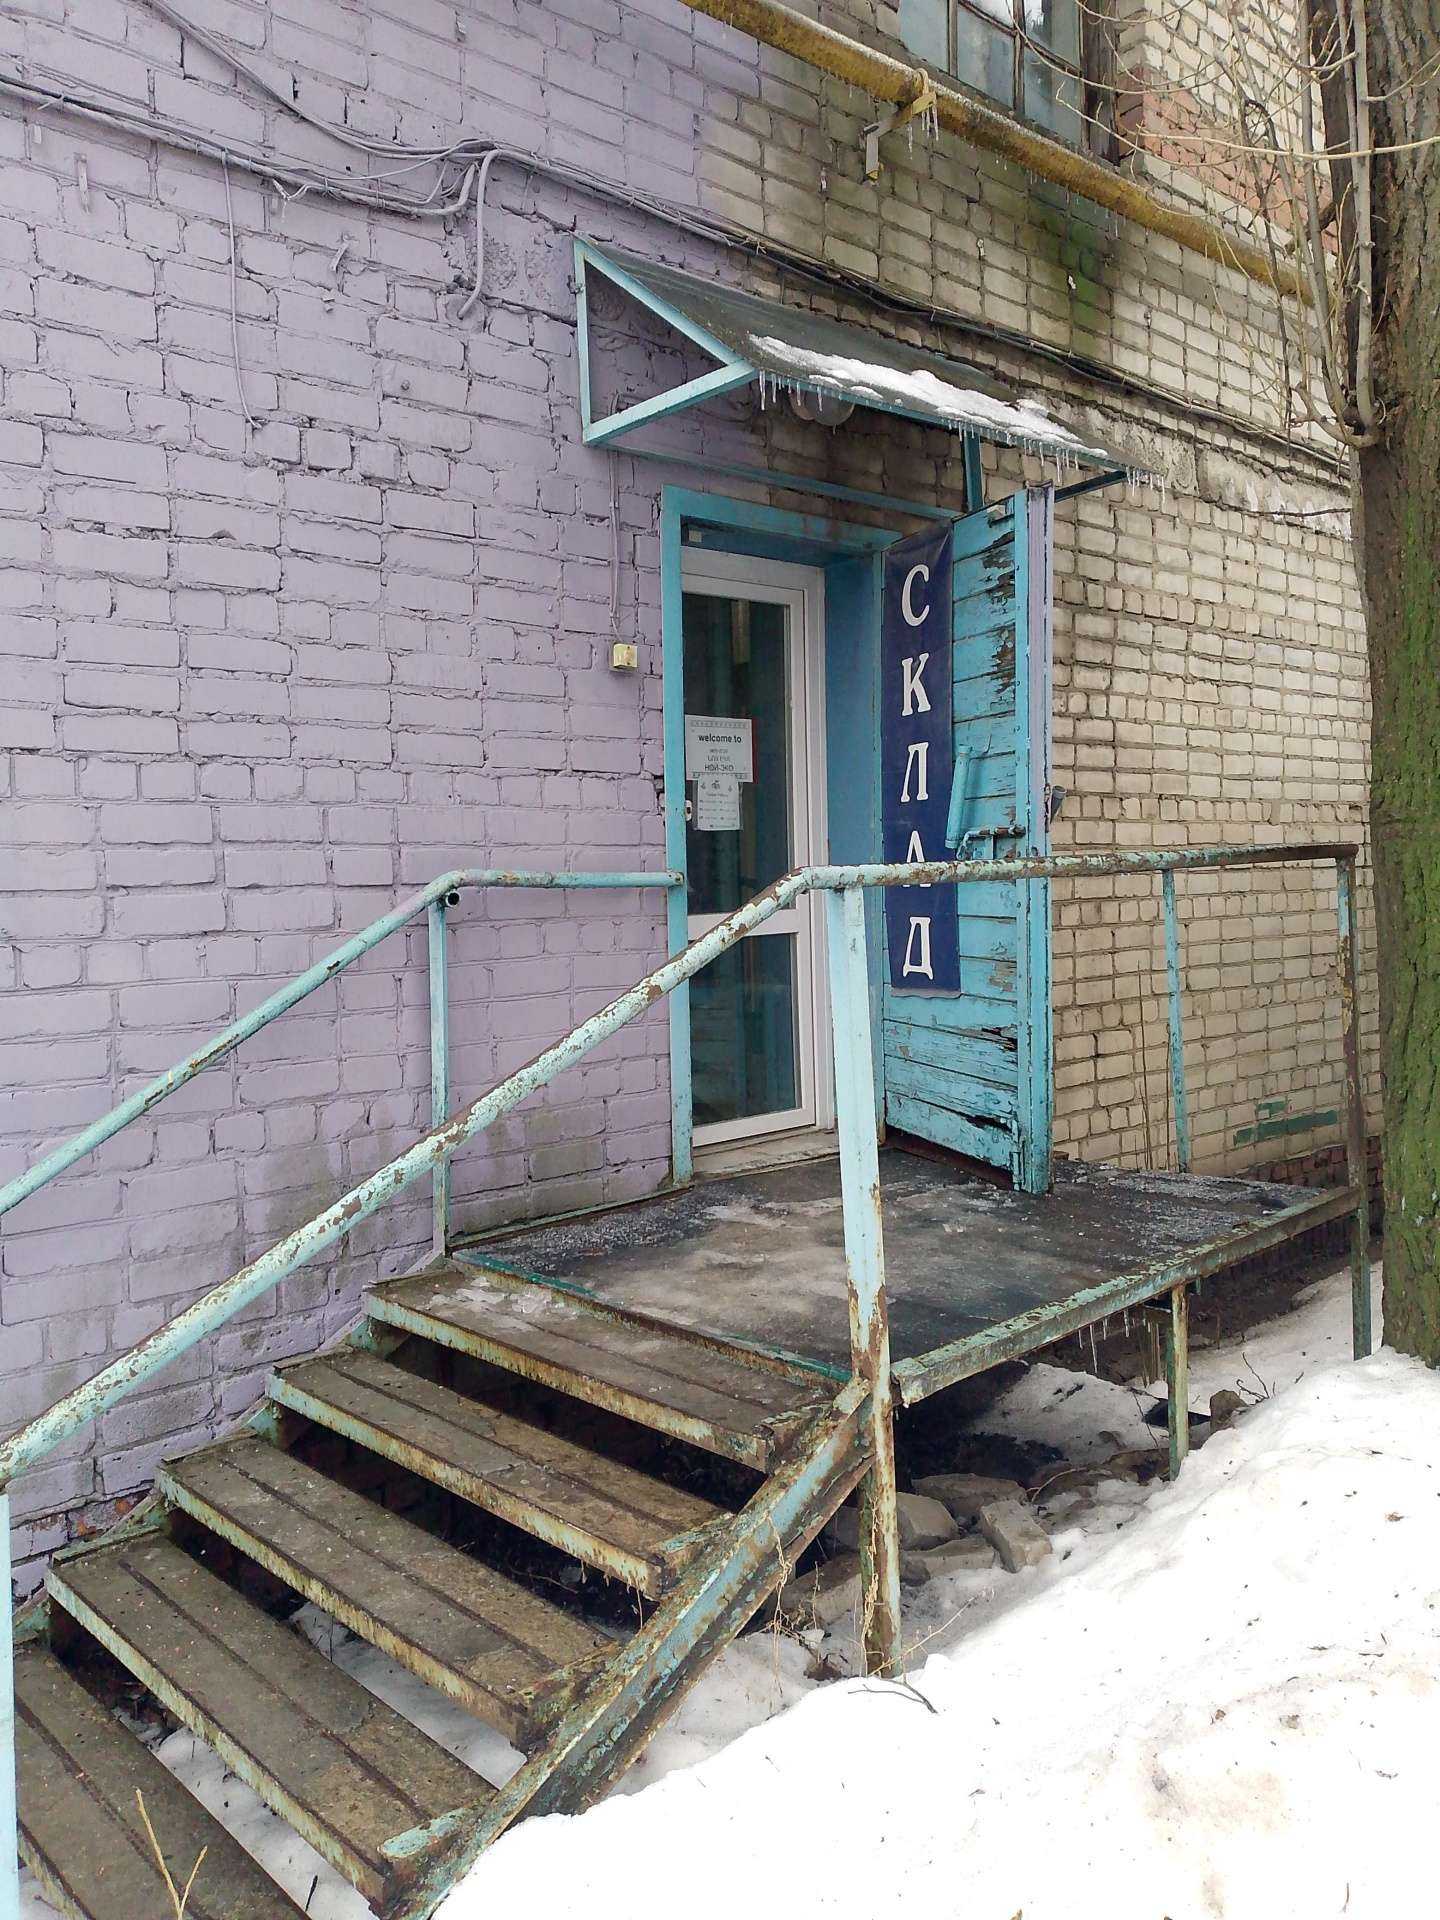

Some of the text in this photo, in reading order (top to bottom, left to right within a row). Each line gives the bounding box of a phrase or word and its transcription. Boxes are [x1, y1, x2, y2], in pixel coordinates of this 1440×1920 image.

[698, 733, 742, 743] welcome to
[901, 564, 933, 980] СКЛАД
